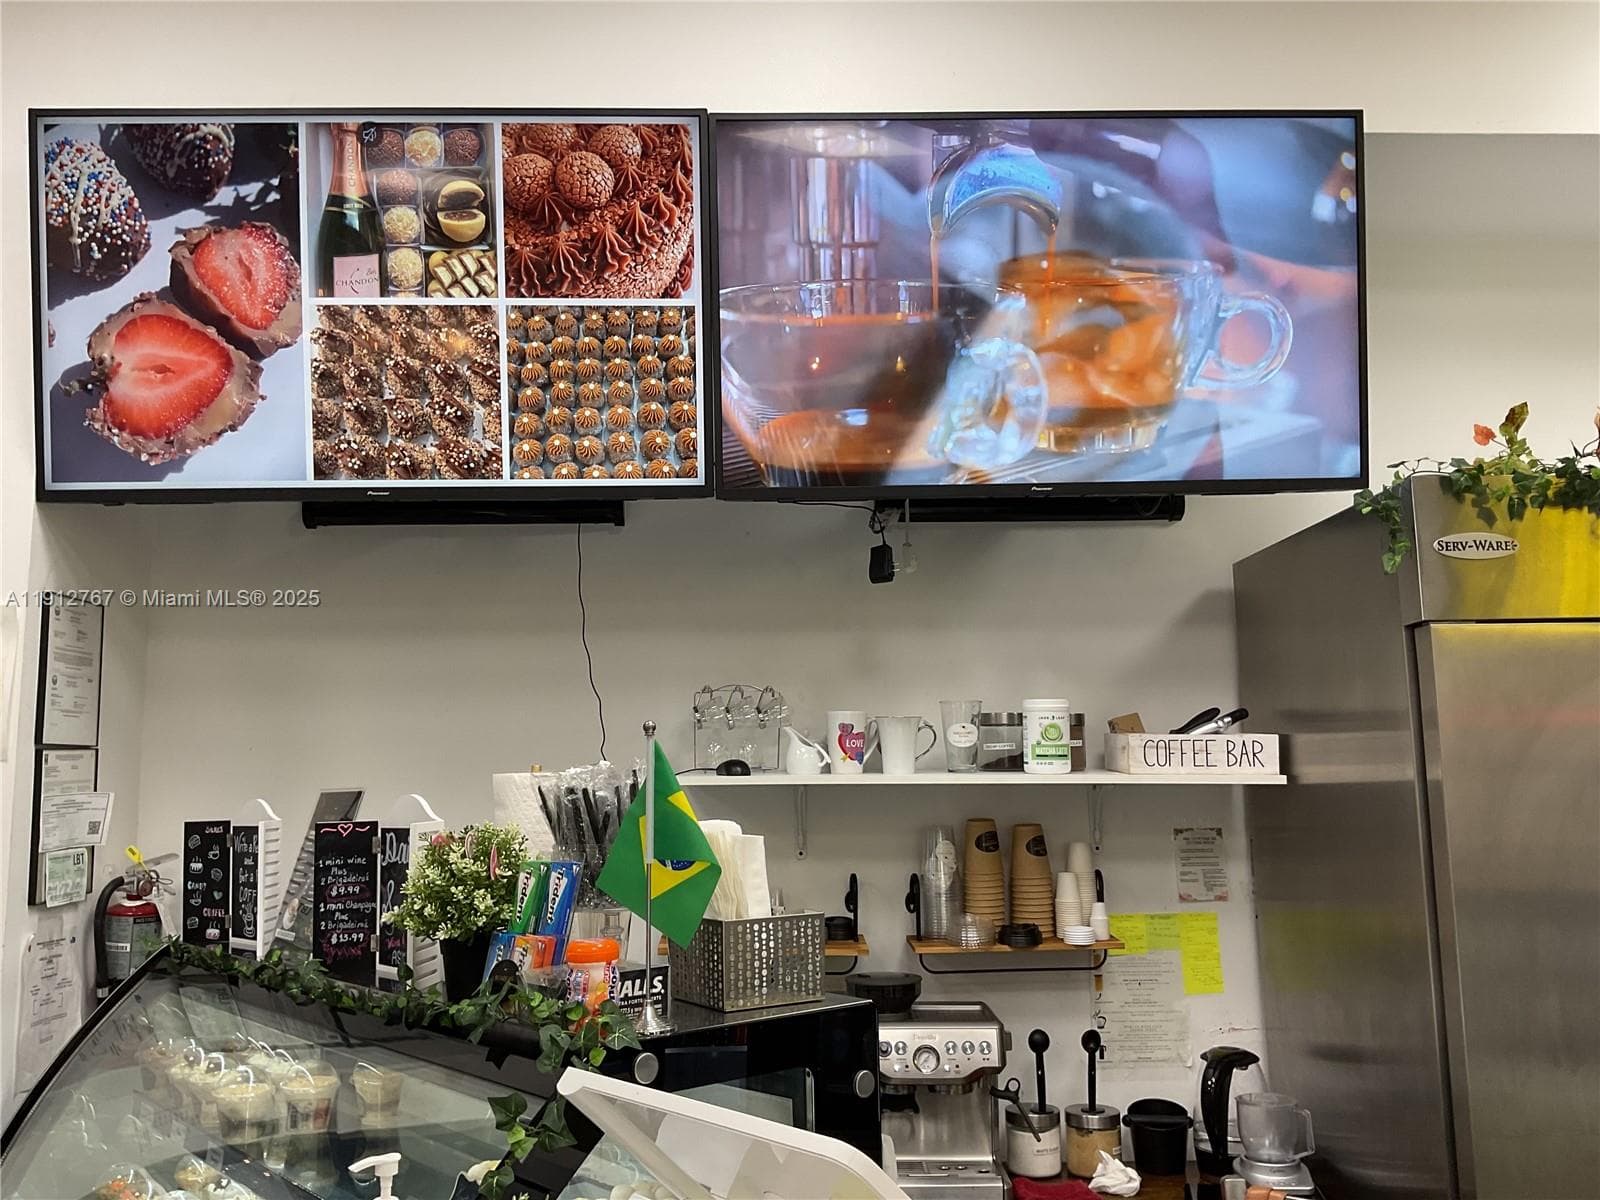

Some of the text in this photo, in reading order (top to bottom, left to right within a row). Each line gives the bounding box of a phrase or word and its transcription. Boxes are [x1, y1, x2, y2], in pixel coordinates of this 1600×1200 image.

[1437, 540, 1511, 551] SERV-WARE
[846, 739, 864, 748] LOVE
[1143, 739, 1265, 767] COFFEE BAR
[325, 856, 344, 866] mini
[347, 855, 367, 865] wine
[330, 885, 360, 897] $9.99
[515, 867, 534, 924] Trident
[547, 867, 566, 924] Trident
